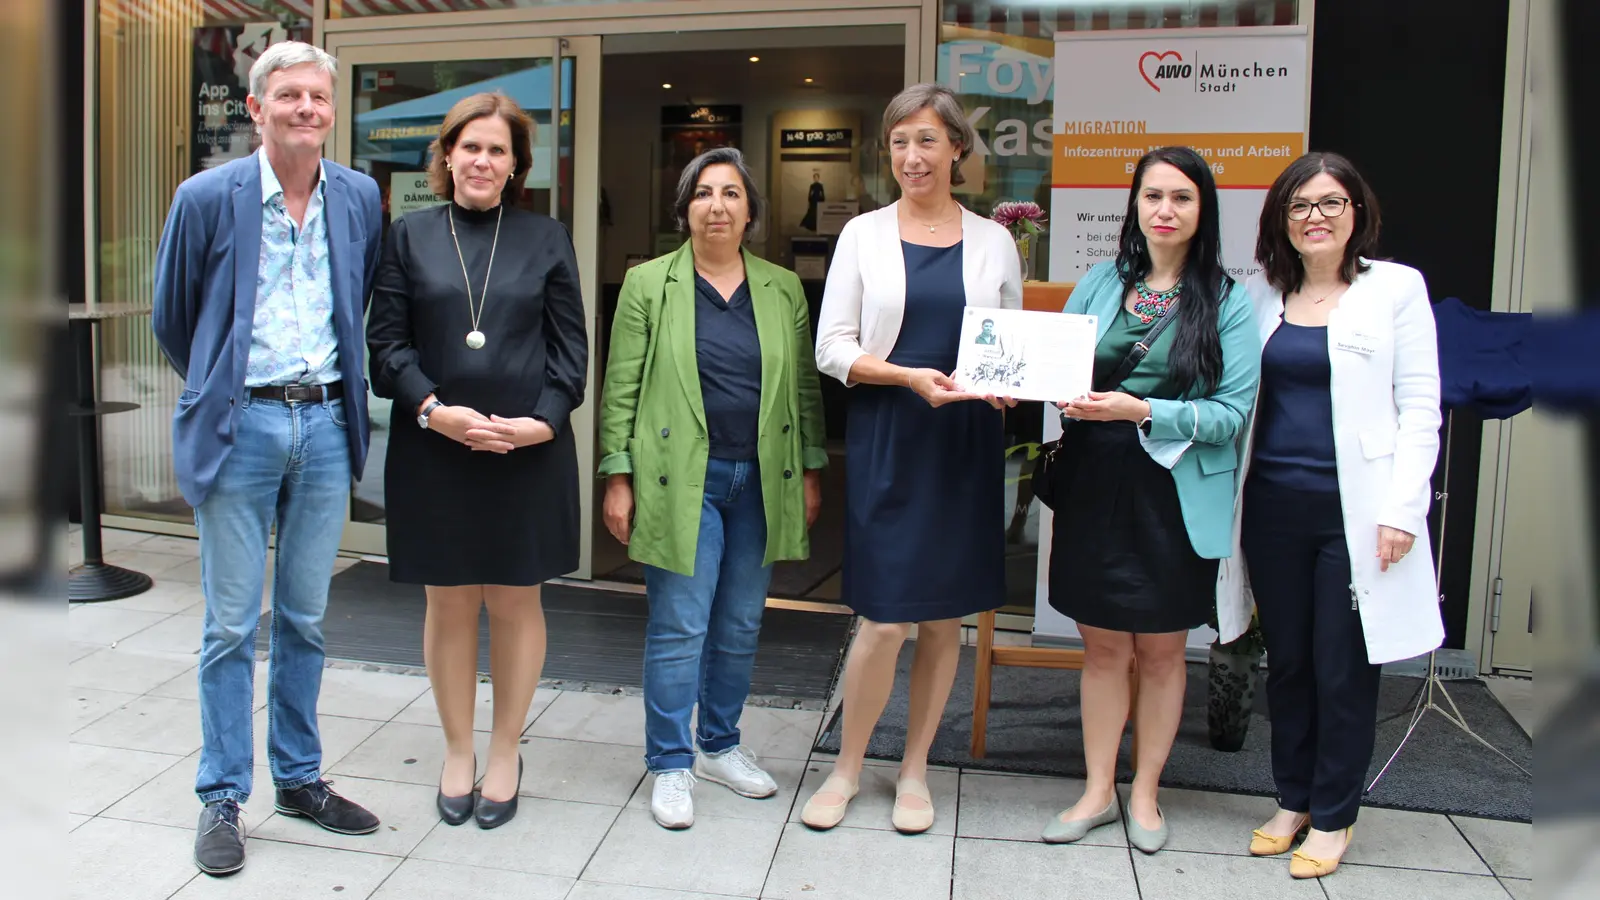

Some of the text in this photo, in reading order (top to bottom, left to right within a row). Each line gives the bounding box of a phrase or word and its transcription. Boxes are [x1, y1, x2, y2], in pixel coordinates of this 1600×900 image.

[1155, 64, 1192, 79] AWO
[1200, 61, 1288, 78] München
[198, 82, 229, 101] App
[1200, 82, 1236, 93] Stadt
[198, 101, 220, 116] ins
[1064, 120, 1147, 135] MIGRATION
[1064, 145, 1144, 158] Infozentrum
[1217, 145, 1244, 157] und
[1247, 145, 1291, 157] Arbeit
[1076, 212, 1095, 222] Wir
[1086, 232, 1102, 242] bei
[1226, 267, 1244, 276] rse
